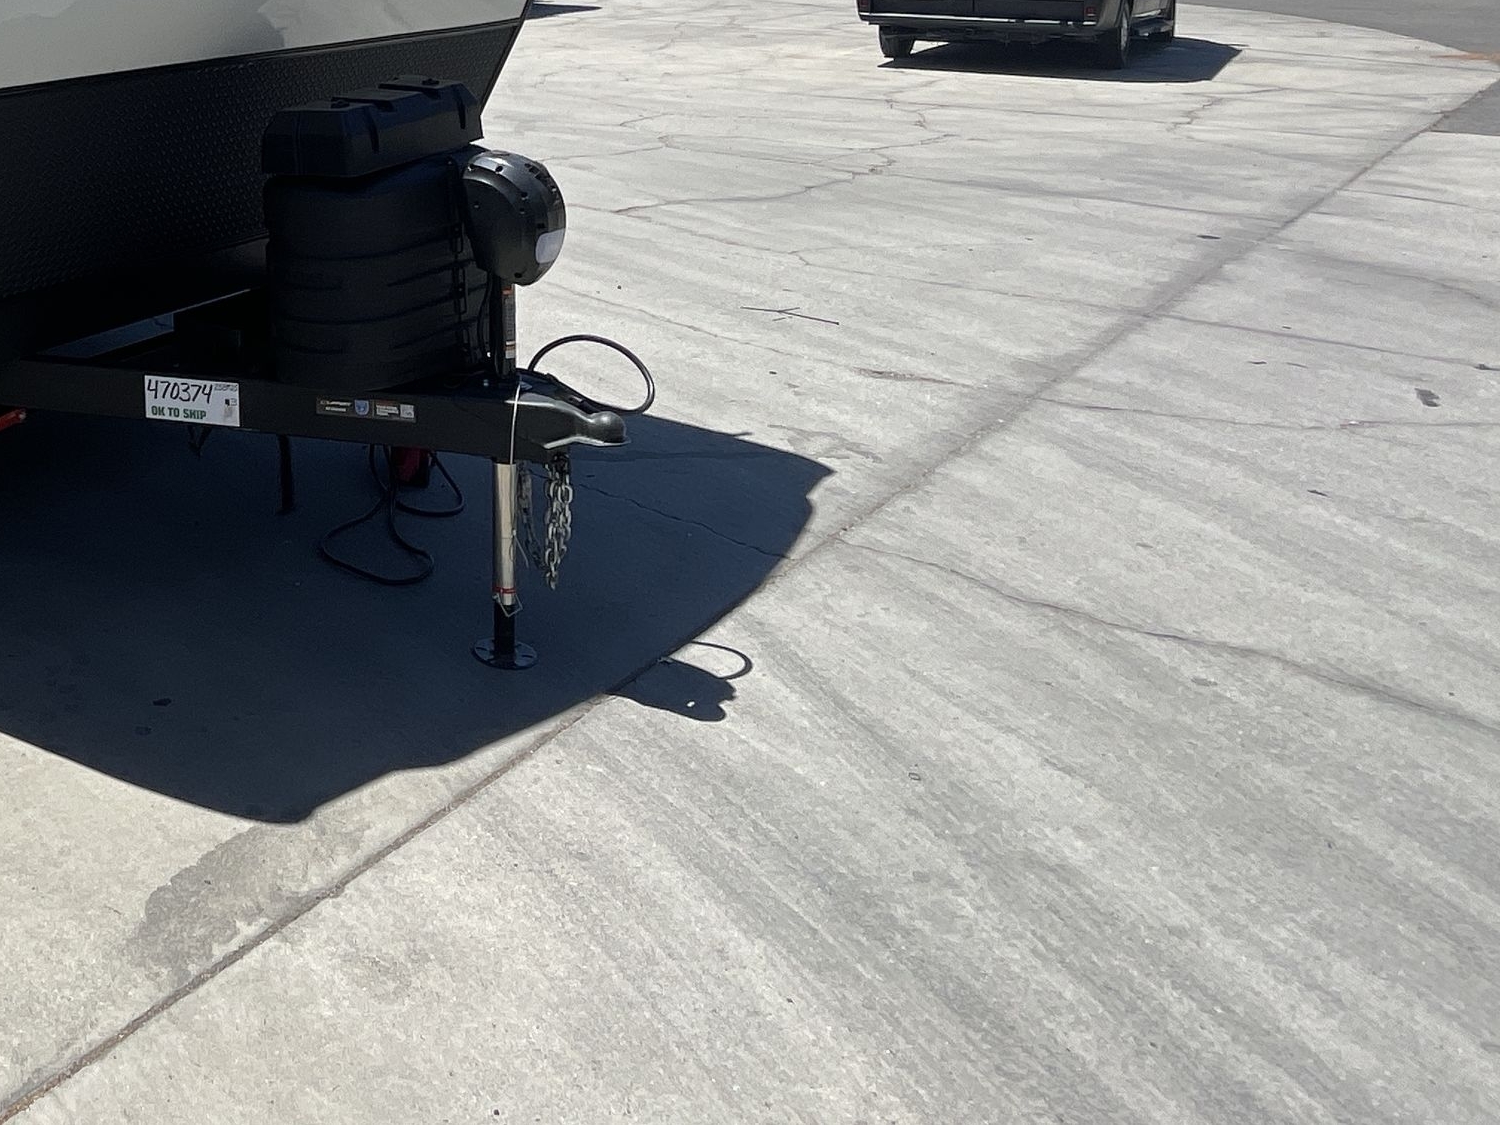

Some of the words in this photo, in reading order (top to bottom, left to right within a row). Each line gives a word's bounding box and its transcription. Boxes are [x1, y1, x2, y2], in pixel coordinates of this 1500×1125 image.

[147, 379, 213, 404] 470374
[151, 405, 166, 417] OK
[167, 407, 180, 418] TO
[183, 408, 207, 420] SHIP
